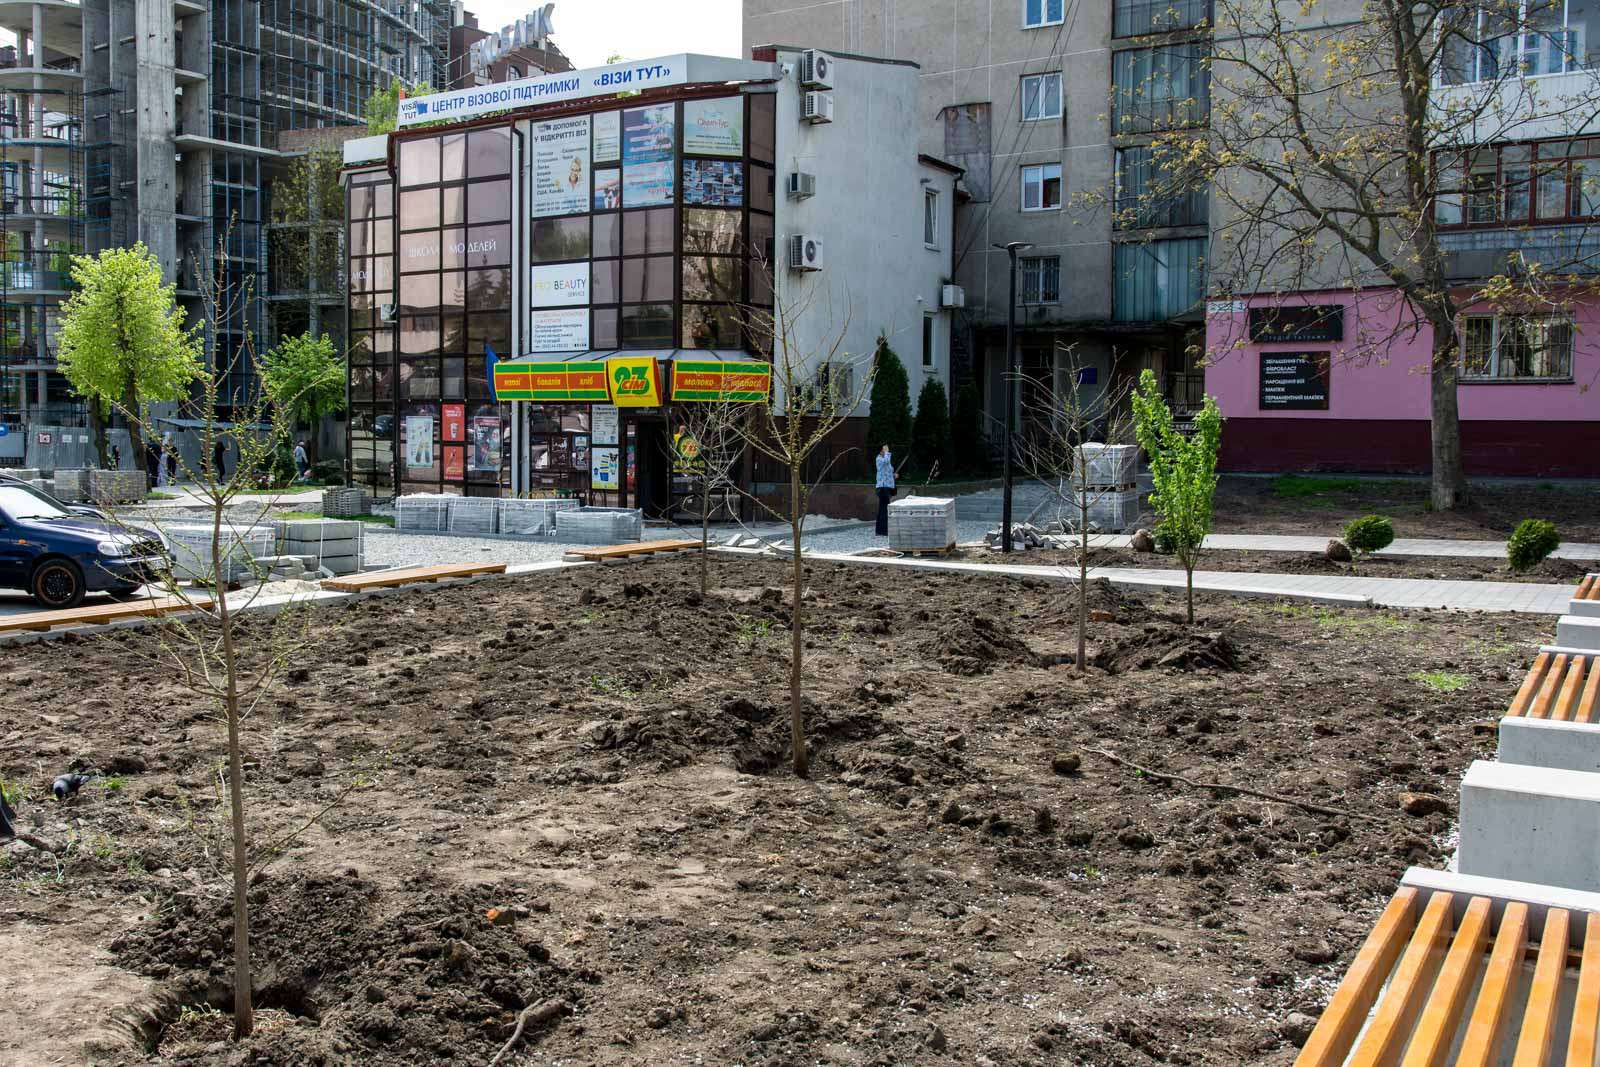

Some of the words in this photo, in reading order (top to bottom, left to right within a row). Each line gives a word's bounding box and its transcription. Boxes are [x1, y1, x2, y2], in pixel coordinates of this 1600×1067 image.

[432, 97, 465, 114] ЦЕНТР
[468, 87, 511, 107] ВІЗОВОЇ
[513, 78, 580, 102] ПІДТРИМКИ
[593, 72, 632, 88] «ВІЗИ
[637, 66, 671, 82] ТУТ»
[401, 103, 416, 111] VISA
[552, 119, 587, 130] ДОПОМОГА
[540, 130, 575, 142] ВІДКРИТТІ
[449, 240, 497, 255] МОДЕЛЕЙ
[554, 279, 586, 290] BEAUTY
